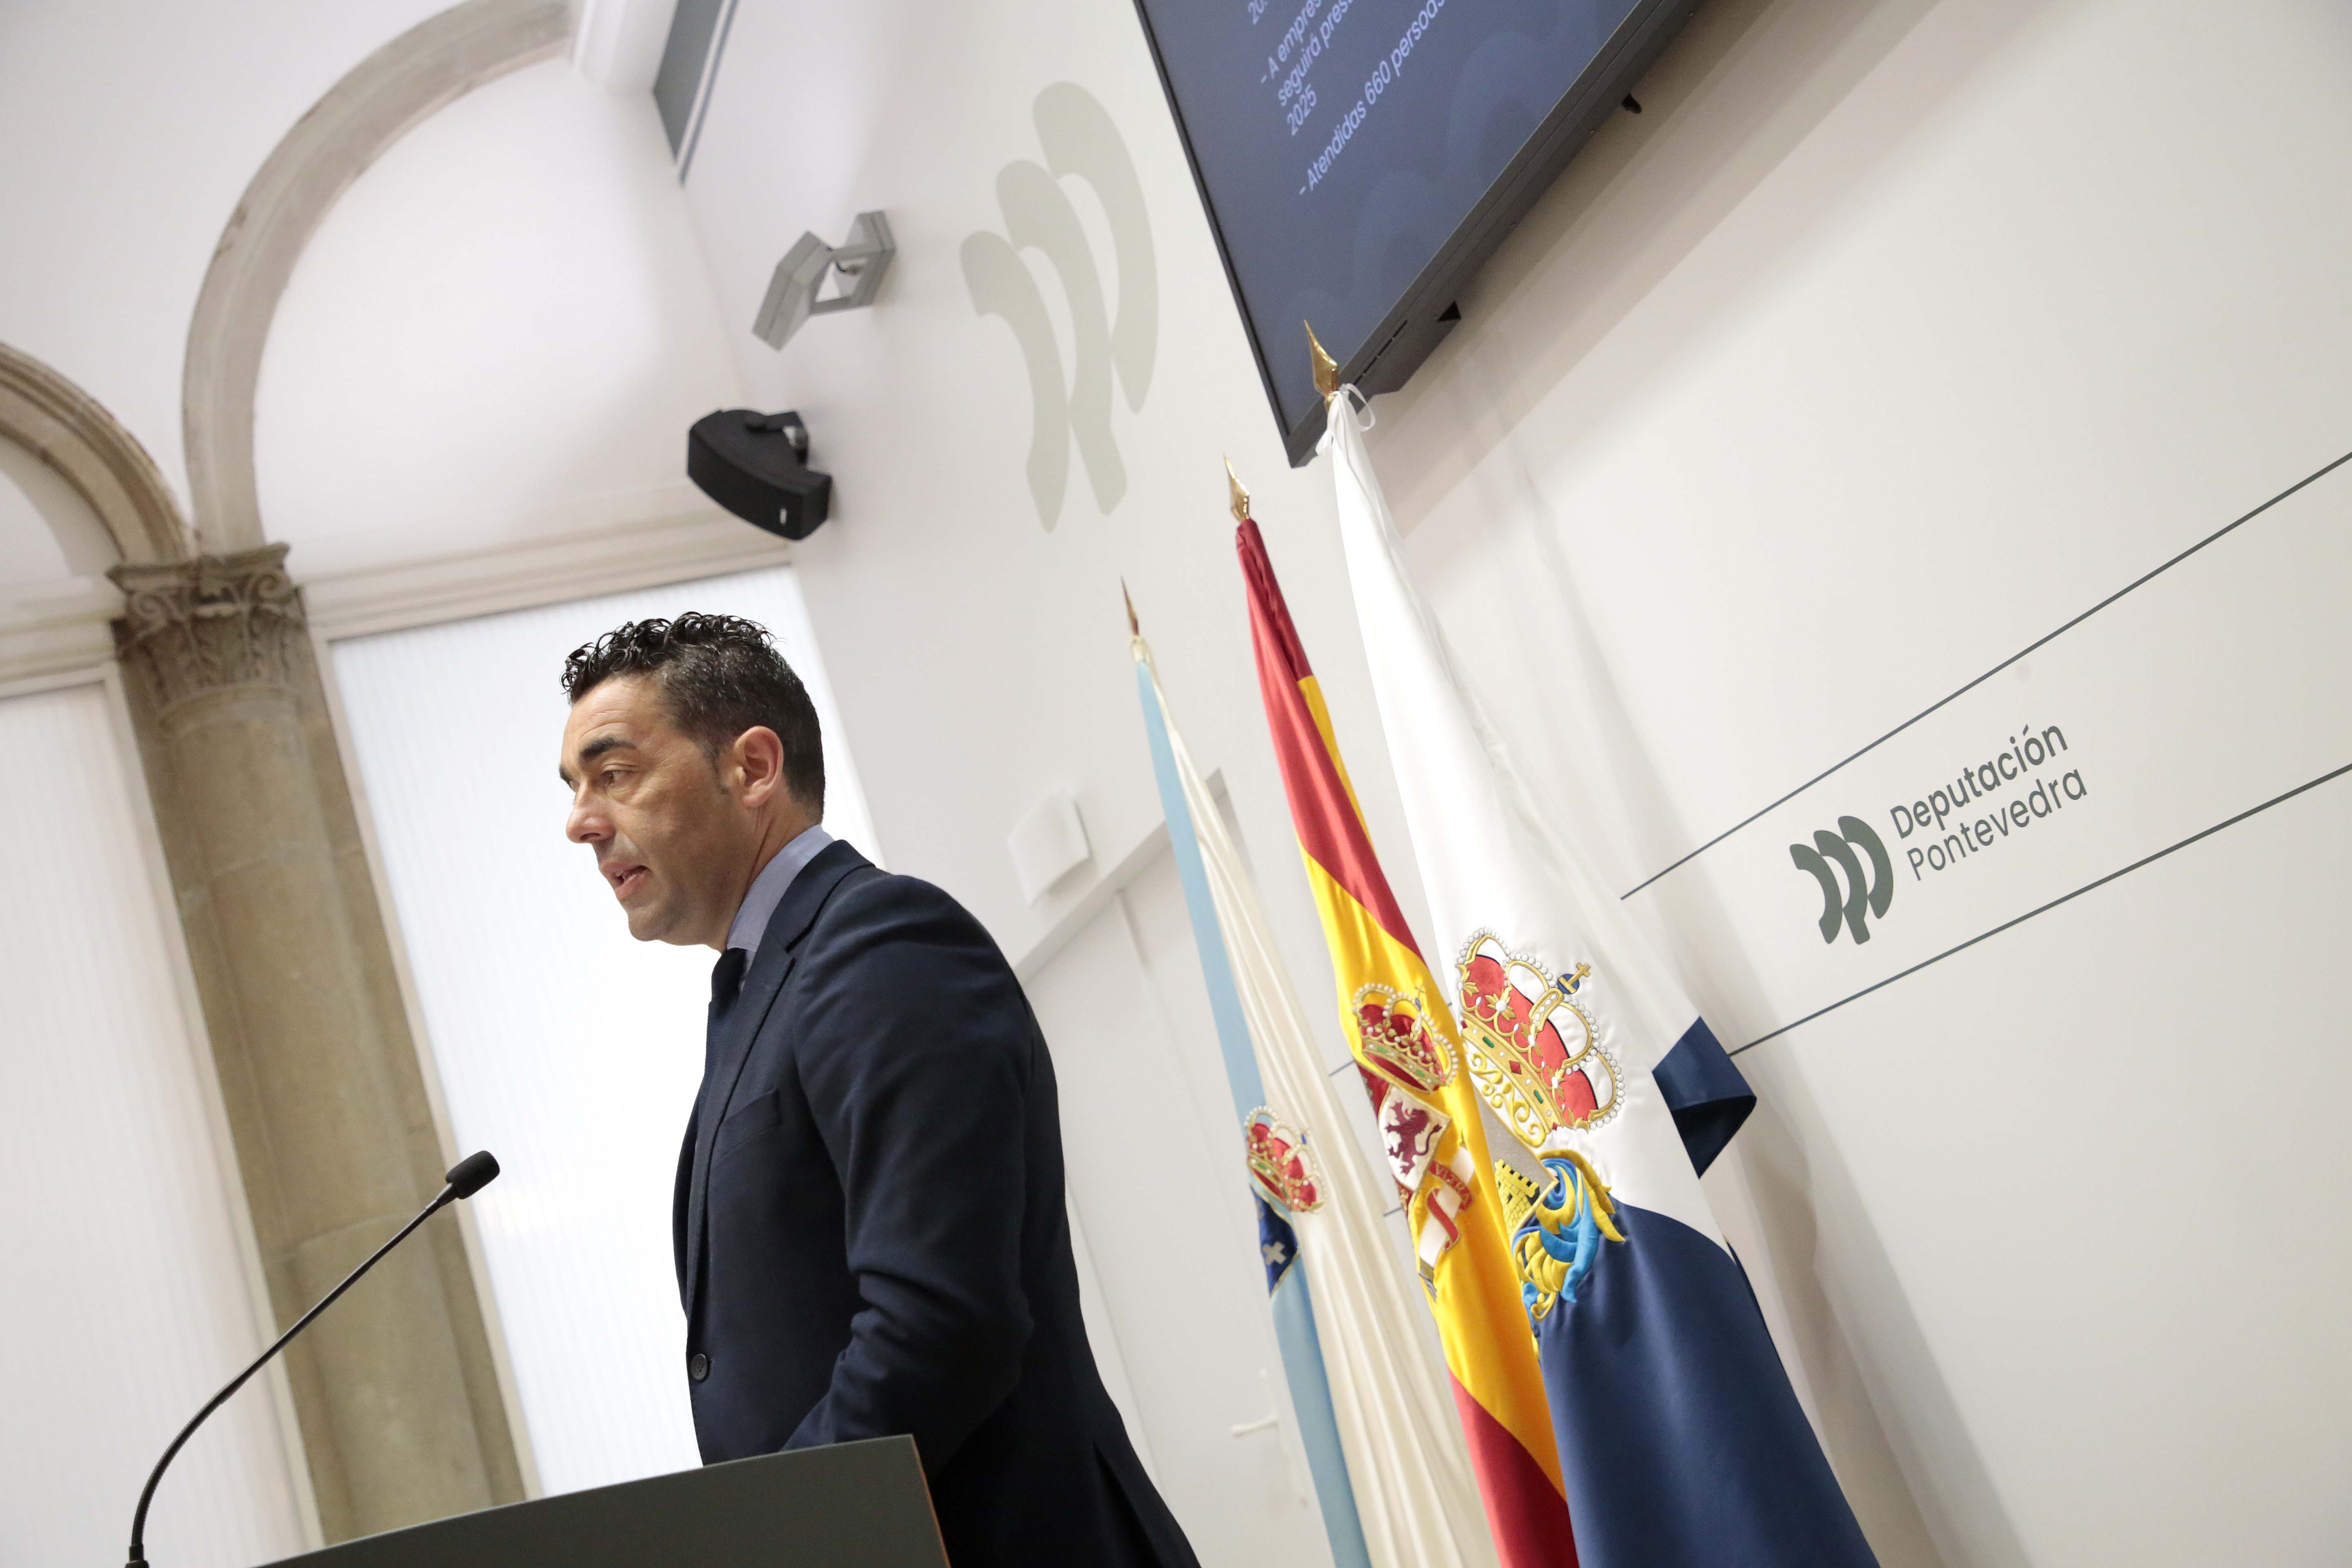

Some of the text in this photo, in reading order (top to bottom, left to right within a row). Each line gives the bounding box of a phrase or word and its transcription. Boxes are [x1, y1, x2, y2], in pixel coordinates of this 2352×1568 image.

[1248, 0, 1267, 25] 20
[1320, 0, 1353, 49] pres
[1268, 56, 1280, 79] A
[1287, 83, 1317, 136] 2025
[1307, 100, 1366, 191] Atendidas
[1364, 60, 1391, 105] 660
[1889, 724, 2069, 840] Deputación
[1906, 768, 2088, 882] Pontevedra
